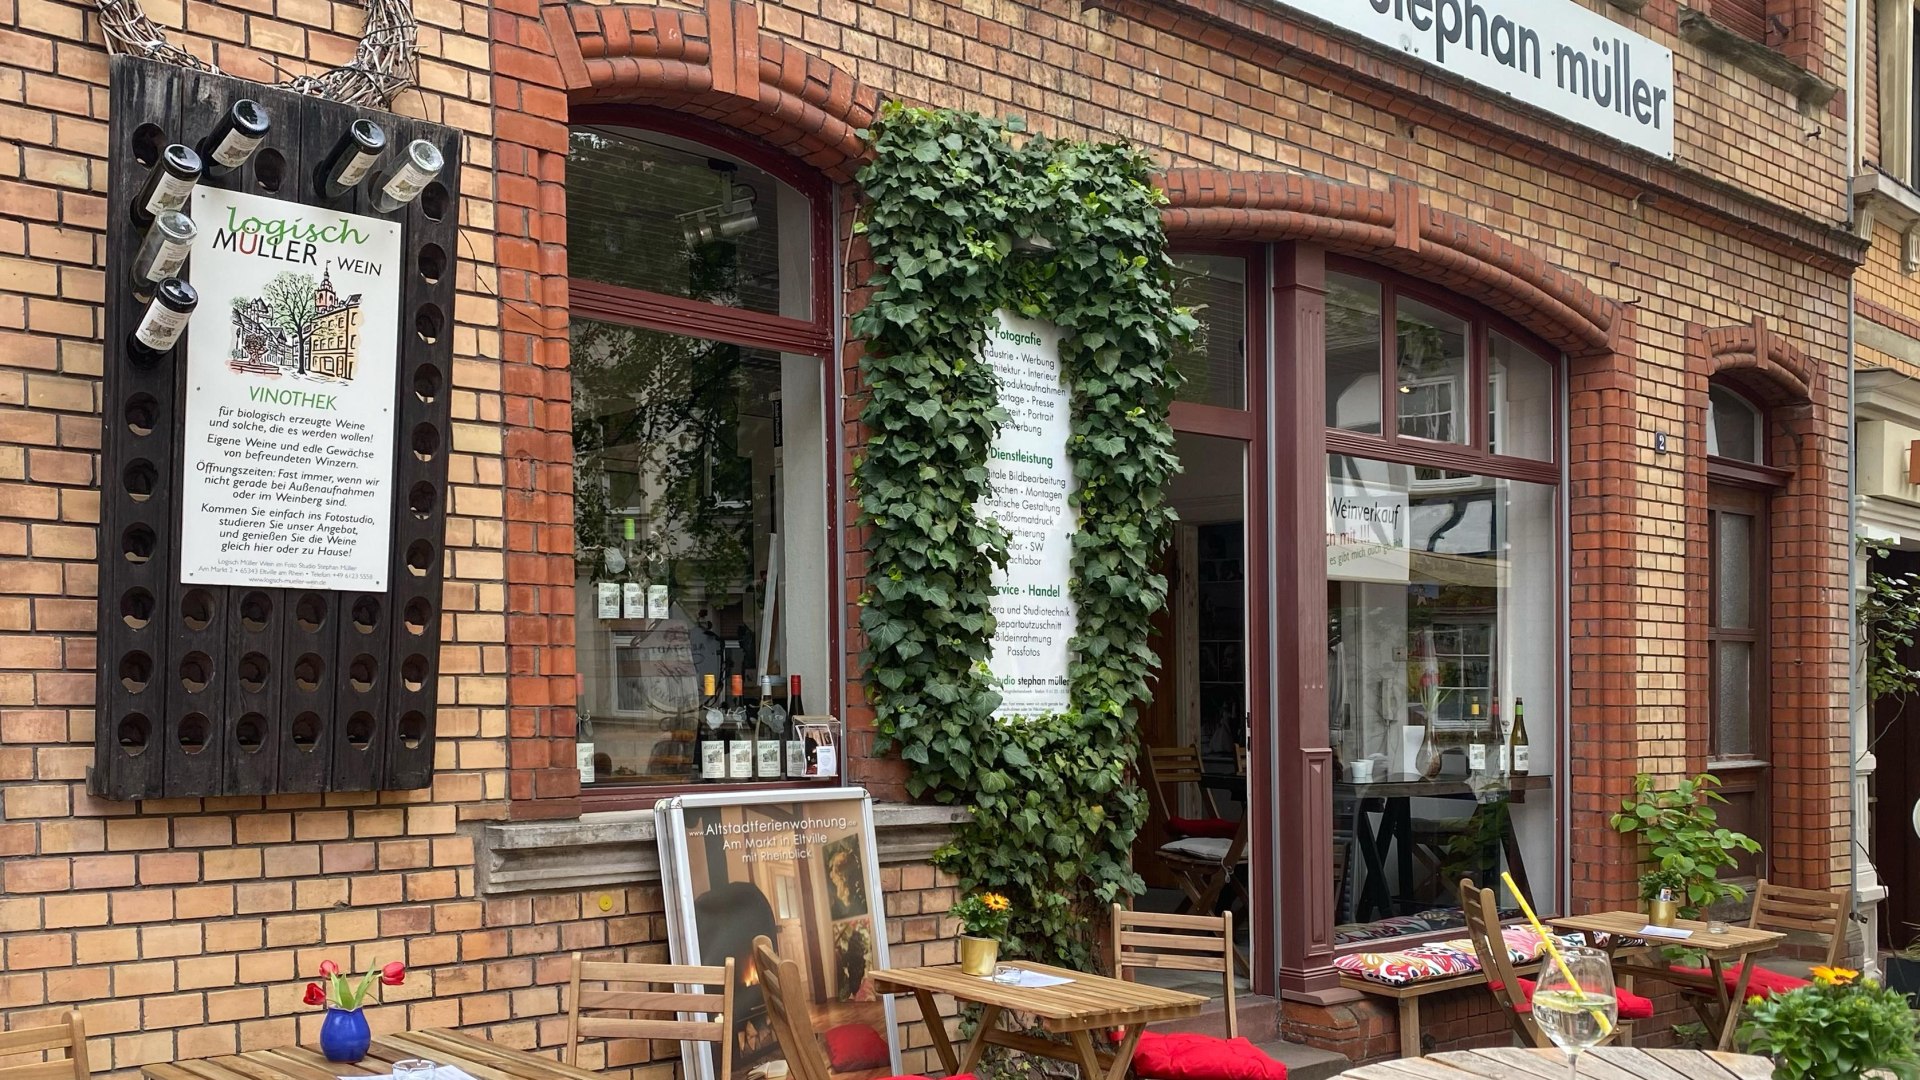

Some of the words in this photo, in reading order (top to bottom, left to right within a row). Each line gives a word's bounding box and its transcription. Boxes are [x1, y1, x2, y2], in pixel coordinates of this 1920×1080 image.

[1556, 36, 1667, 130] müller
[227, 206, 370, 245] logisch
[212, 226, 317, 265] MÜLLER
[337, 256, 382, 276] WEIN
[995, 329, 1041, 345] Fotografie
[1021, 353, 1054, 369] Werbung
[1028, 368, 1057, 381] Interieur
[250, 386, 337, 410] VINOTHEK
[1032, 396, 1054, 408] Presse
[219, 406, 234, 417] für
[237, 408, 285, 422] biologisch
[289, 416, 331, 427] erzeugte
[336, 419, 365, 430] Weine
[1028, 409, 1054, 421] Portrait
[209, 419, 229, 428] und
[233, 422, 267, 433] solche,
[269, 424, 284, 434] die
[288, 427, 298, 435] es
[302, 428, 337, 439] werden
[341, 430, 373, 443] wollen!
[207, 434, 240, 445] Eigene
[245, 437, 276, 449] Weine
[280, 441, 299, 451] und
[303, 443, 322, 453] edle
[326, 446, 374, 458] Gewächse
[1659, 434, 1665, 450] 2
[245, 450, 311, 464] befreundeten
[316, 456, 358, 469] Winzern.
[991, 447, 1053, 469] Dienstleistung
[196, 461, 276, 478] Öffnungszeiten:
[278, 469, 298, 479] Fast
[301, 471, 334, 483] immer,
[337, 476, 362, 485] wenn
[366, 478, 380, 486] wir
[1009, 471, 1065, 488] Bildbearbeitung
[205, 477, 229, 485] nicht
[233, 479, 267, 490] gerade
[271, 481, 285, 490] bei
[289, 484, 374, 497] Außenaufnahmen
[1026, 488, 1062, 501] Montagen
[233, 491, 255, 499] oder
[259, 492, 271, 500] im
[276, 494, 322, 507] Weinberg
[326, 497, 347, 506] sind.
[984, 497, 1019, 509] Grafische
[1022, 500, 1060, 515] Gestaltung
[201, 503, 247, 515] Kommen
[251, 507, 265, 516] Sie
[269, 508, 304, 519] einfach
[308, 512, 321, 520] ins
[325, 513, 375, 525] Fotostudio,
[991, 511, 1054, 526] Großformatdruck
[1330, 497, 1400, 529] Weinverkauf
[219, 518, 265, 528] studieren
[269, 521, 284, 529] Sie
[287, 523, 314, 531] unser
[317, 525, 358, 535] Angebot,
[219, 530, 239, 538] und
[242, 531, 287, 542] genießen
[291, 534, 304, 542] Sie
[308, 535, 322, 543] die
[327, 537, 356, 545] Weine
[1340, 529, 1356, 546] mit
[221, 542, 250, 552] gleich
[254, 544, 273, 552] hier
[276, 545, 299, 553] oder
[318, 547, 351, 556] Hause!
[1031, 542, 1044, 551] SW
[1009, 555, 1041, 565] achlabor
[1330, 557, 1337, 565] es
[1338, 550, 1350, 566] gibt
[1352, 547, 1365, 560] mich
[1368, 545, 1381, 556] auch
[1029, 584, 1060, 597] Handel
[1007, 606, 1020, 614] und
[1024, 605, 1070, 616] Studiotechnik
[995, 632, 1051, 646] Bildeinrahmung
[1007, 646, 1040, 656] Passfotos
[1018, 676, 1045, 687] stephan
[723, 840, 742, 850] Am
[745, 837, 777, 849] Markt
[780, 836, 789, 846] in
[794, 834, 827, 845] Eltville
[742, 853, 757, 863] mit
[761, 849, 812, 862] Rheinblick
